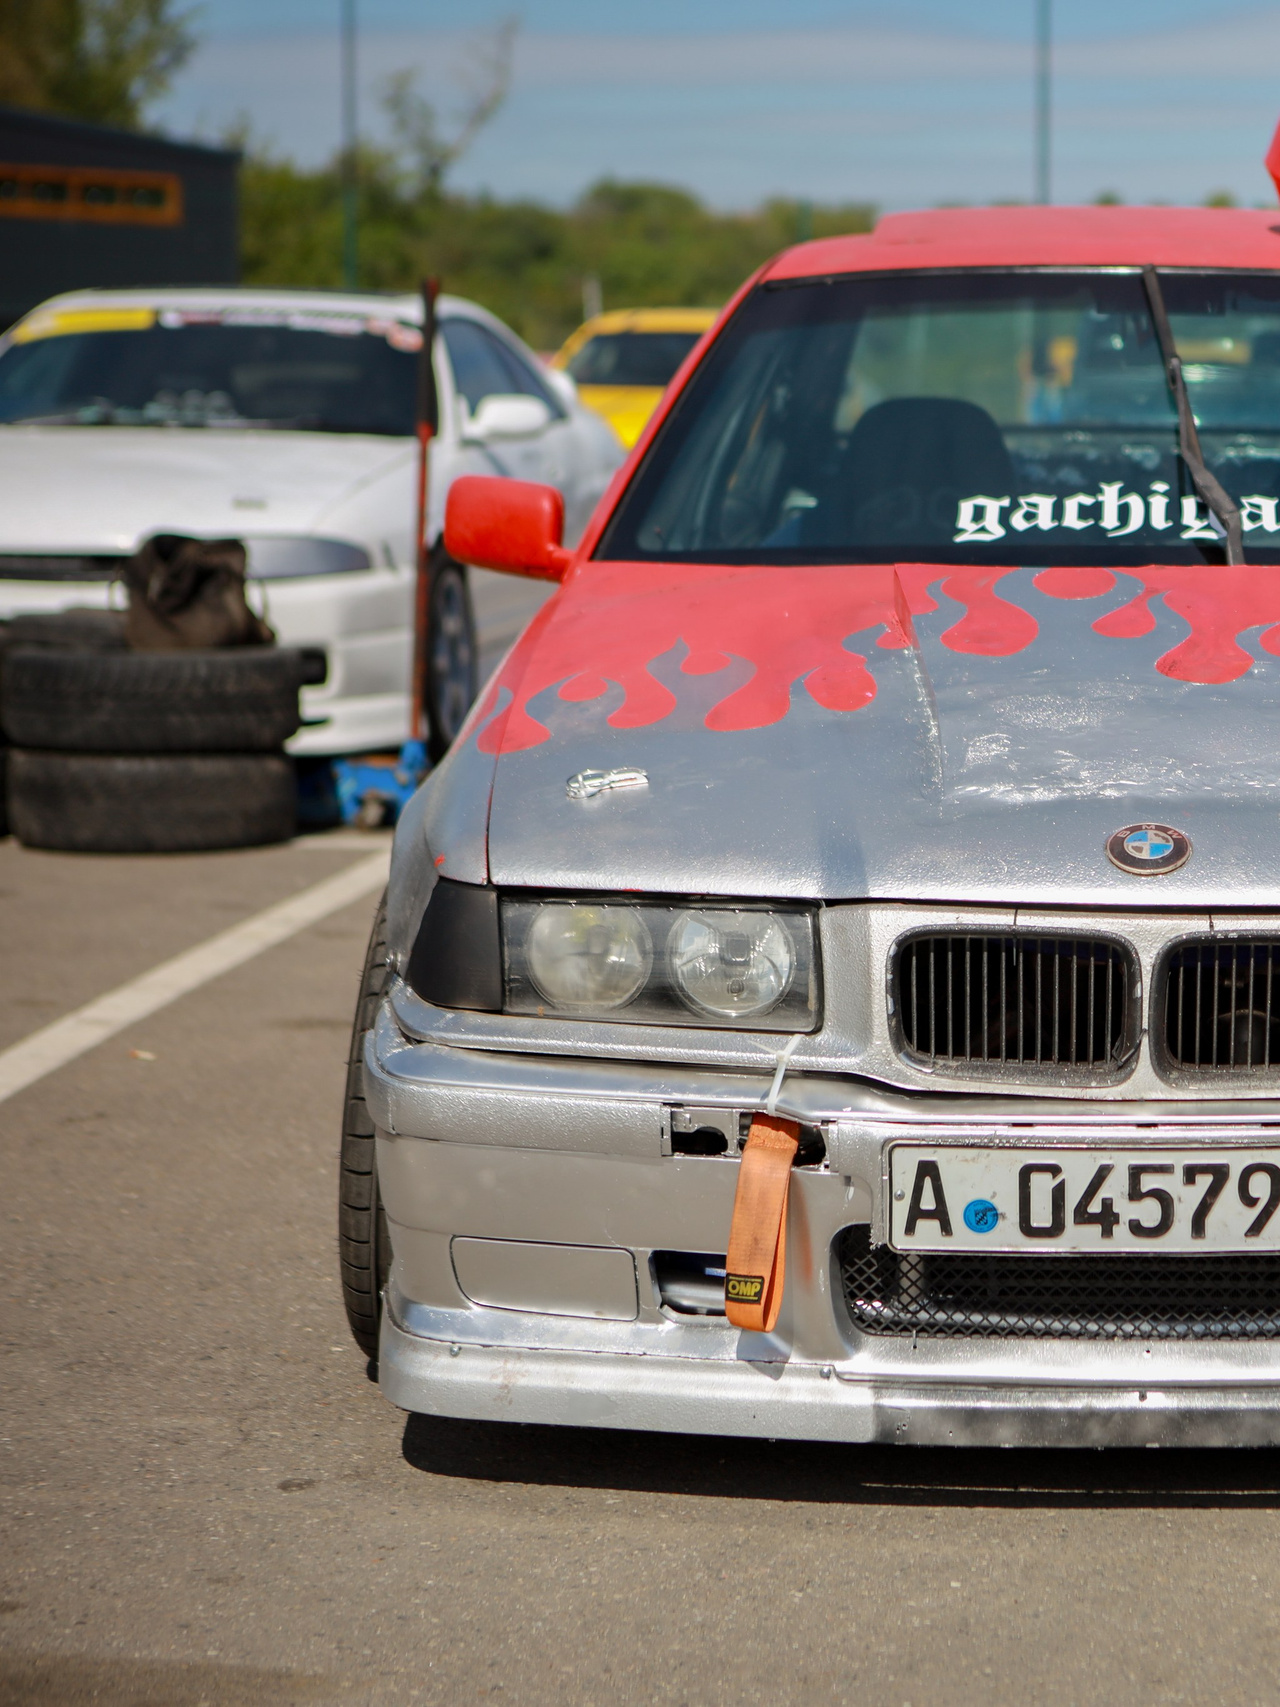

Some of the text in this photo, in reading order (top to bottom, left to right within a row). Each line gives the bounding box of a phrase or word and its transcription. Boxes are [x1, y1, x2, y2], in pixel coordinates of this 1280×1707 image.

[1116, 825, 1182, 839] BMW
[904, 1160, 953, 1237] A
[728, 1280, 761, 1296] OMP
